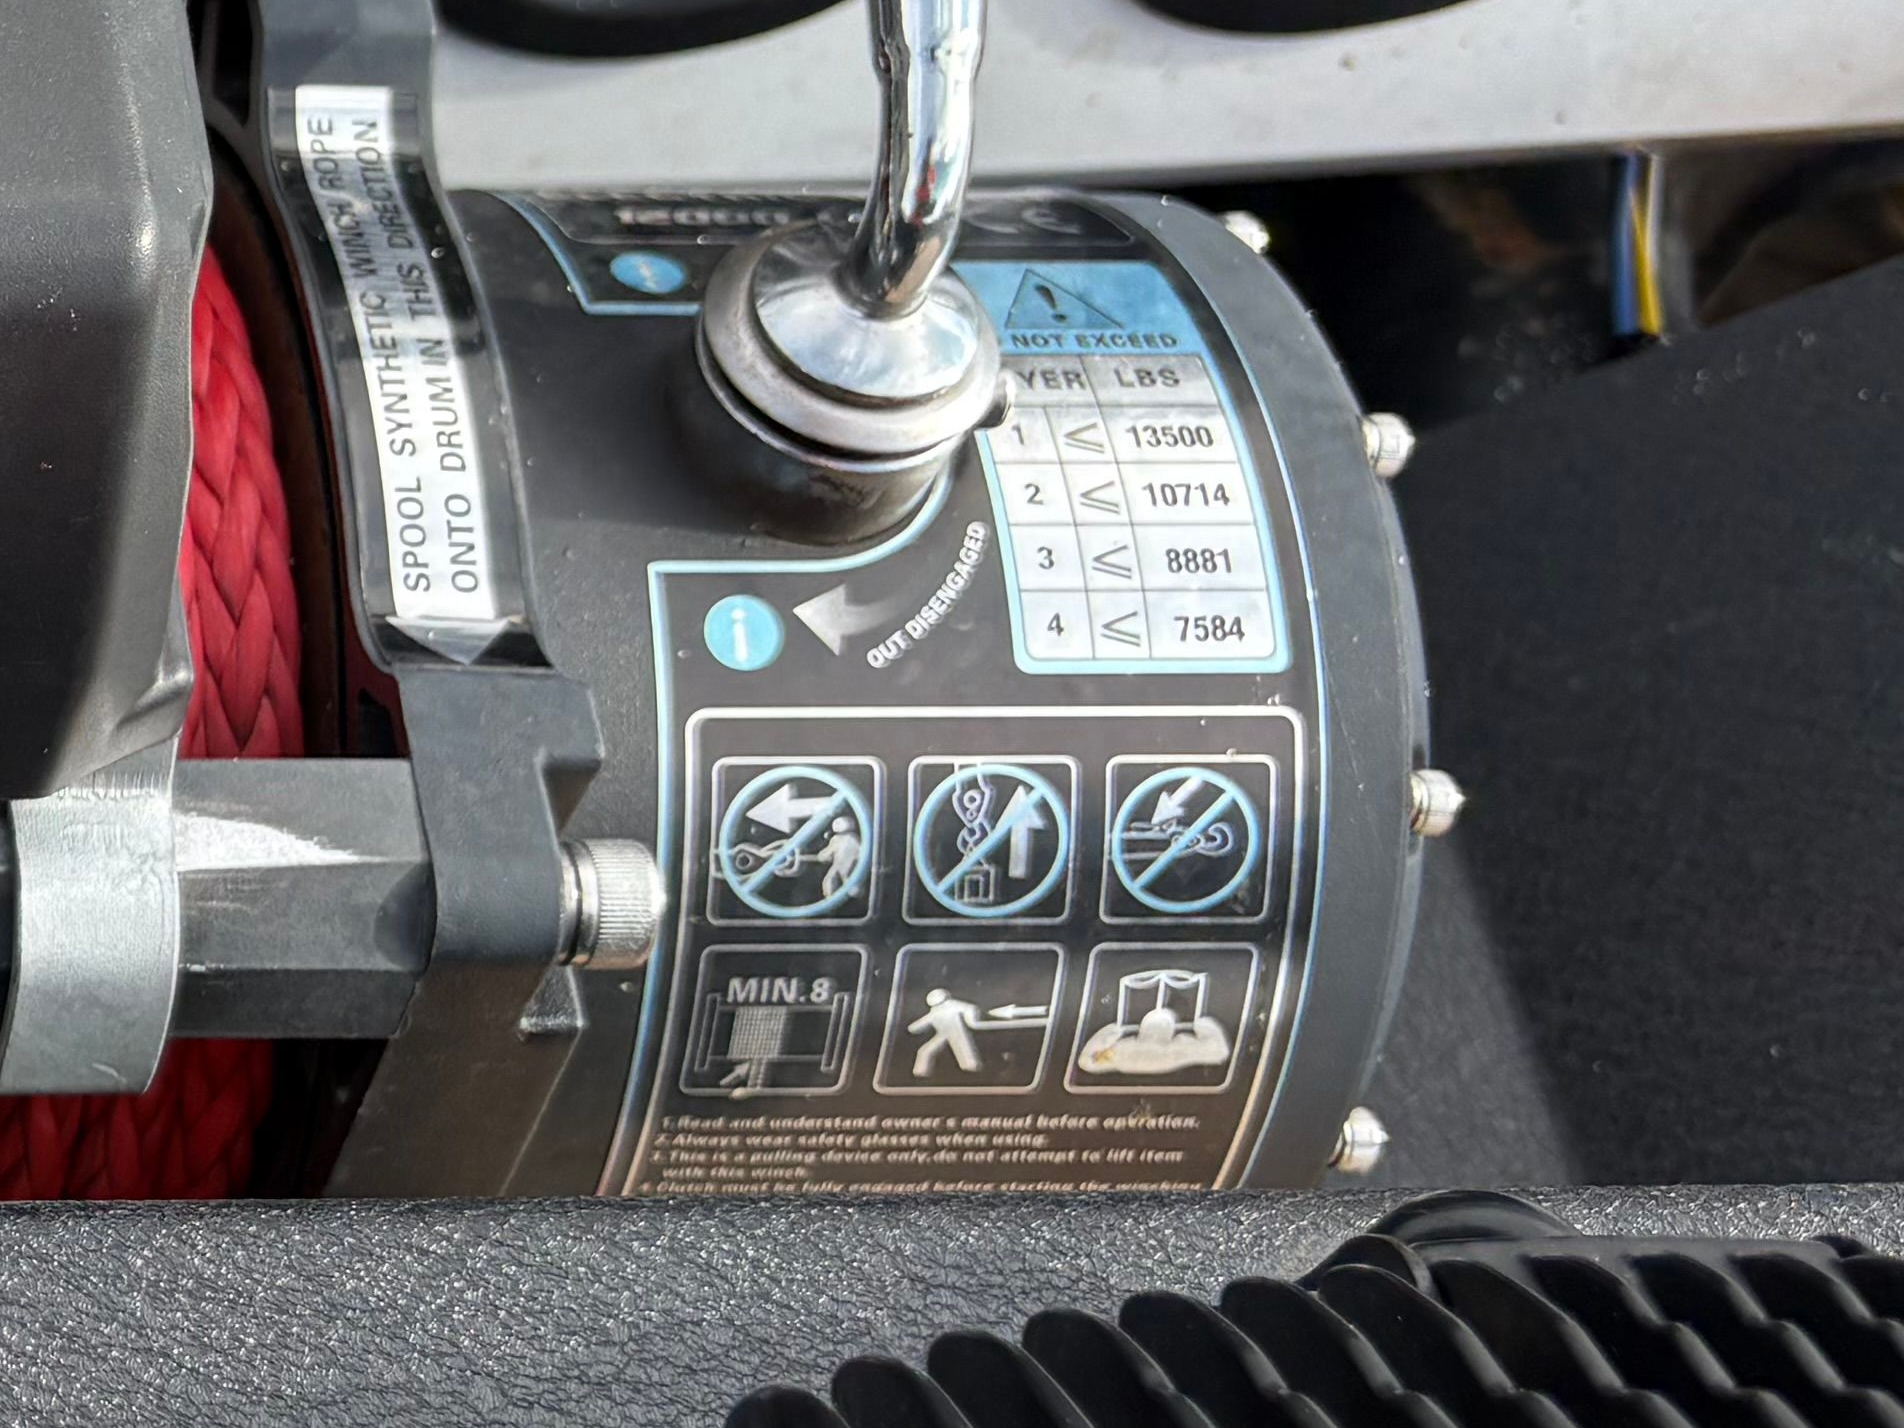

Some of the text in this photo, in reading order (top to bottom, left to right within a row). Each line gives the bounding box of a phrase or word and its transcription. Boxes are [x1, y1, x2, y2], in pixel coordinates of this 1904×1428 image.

[1011, 331, 1179, 349] NOT EXCEED
[307, 116, 432, 593] SPOOL SYNTHETIC WINCH ROPE
[351, 120, 479, 594] ONTO DRUM IN THIS DIRECTION
[1016, 368, 1181, 392] YER LBS
[1010, 424, 1026, 447] 1
[1125, 424, 1214, 449] 13500
[1023, 482, 1046, 506] 2
[1142, 482, 1231, 508] 10714
[1036, 546, 1055, 571] 3
[1165, 547, 1233, 574] 8881
[866, 520, 991, 670] OUT DISENGAGED
[1046, 613, 1065, 637] 4
[1173, 614, 1246, 643] 7584
[729, 1115, 767, 1130] and
[770, 1115, 879, 1130] understand
[961, 1115, 1034, 1130] manual
[1037, 1115, 1101, 1130] before
[797, 1132, 857, 1148] safety
[860, 1132, 931, 1148] glasses
[935, 1132, 988, 1148] when
[750, 1149, 818, 1164] pulling
[820, 1149, 883, 1164] device
[962, 1149, 998, 1164] not
[1000, 1149, 1077, 1164] attempt
